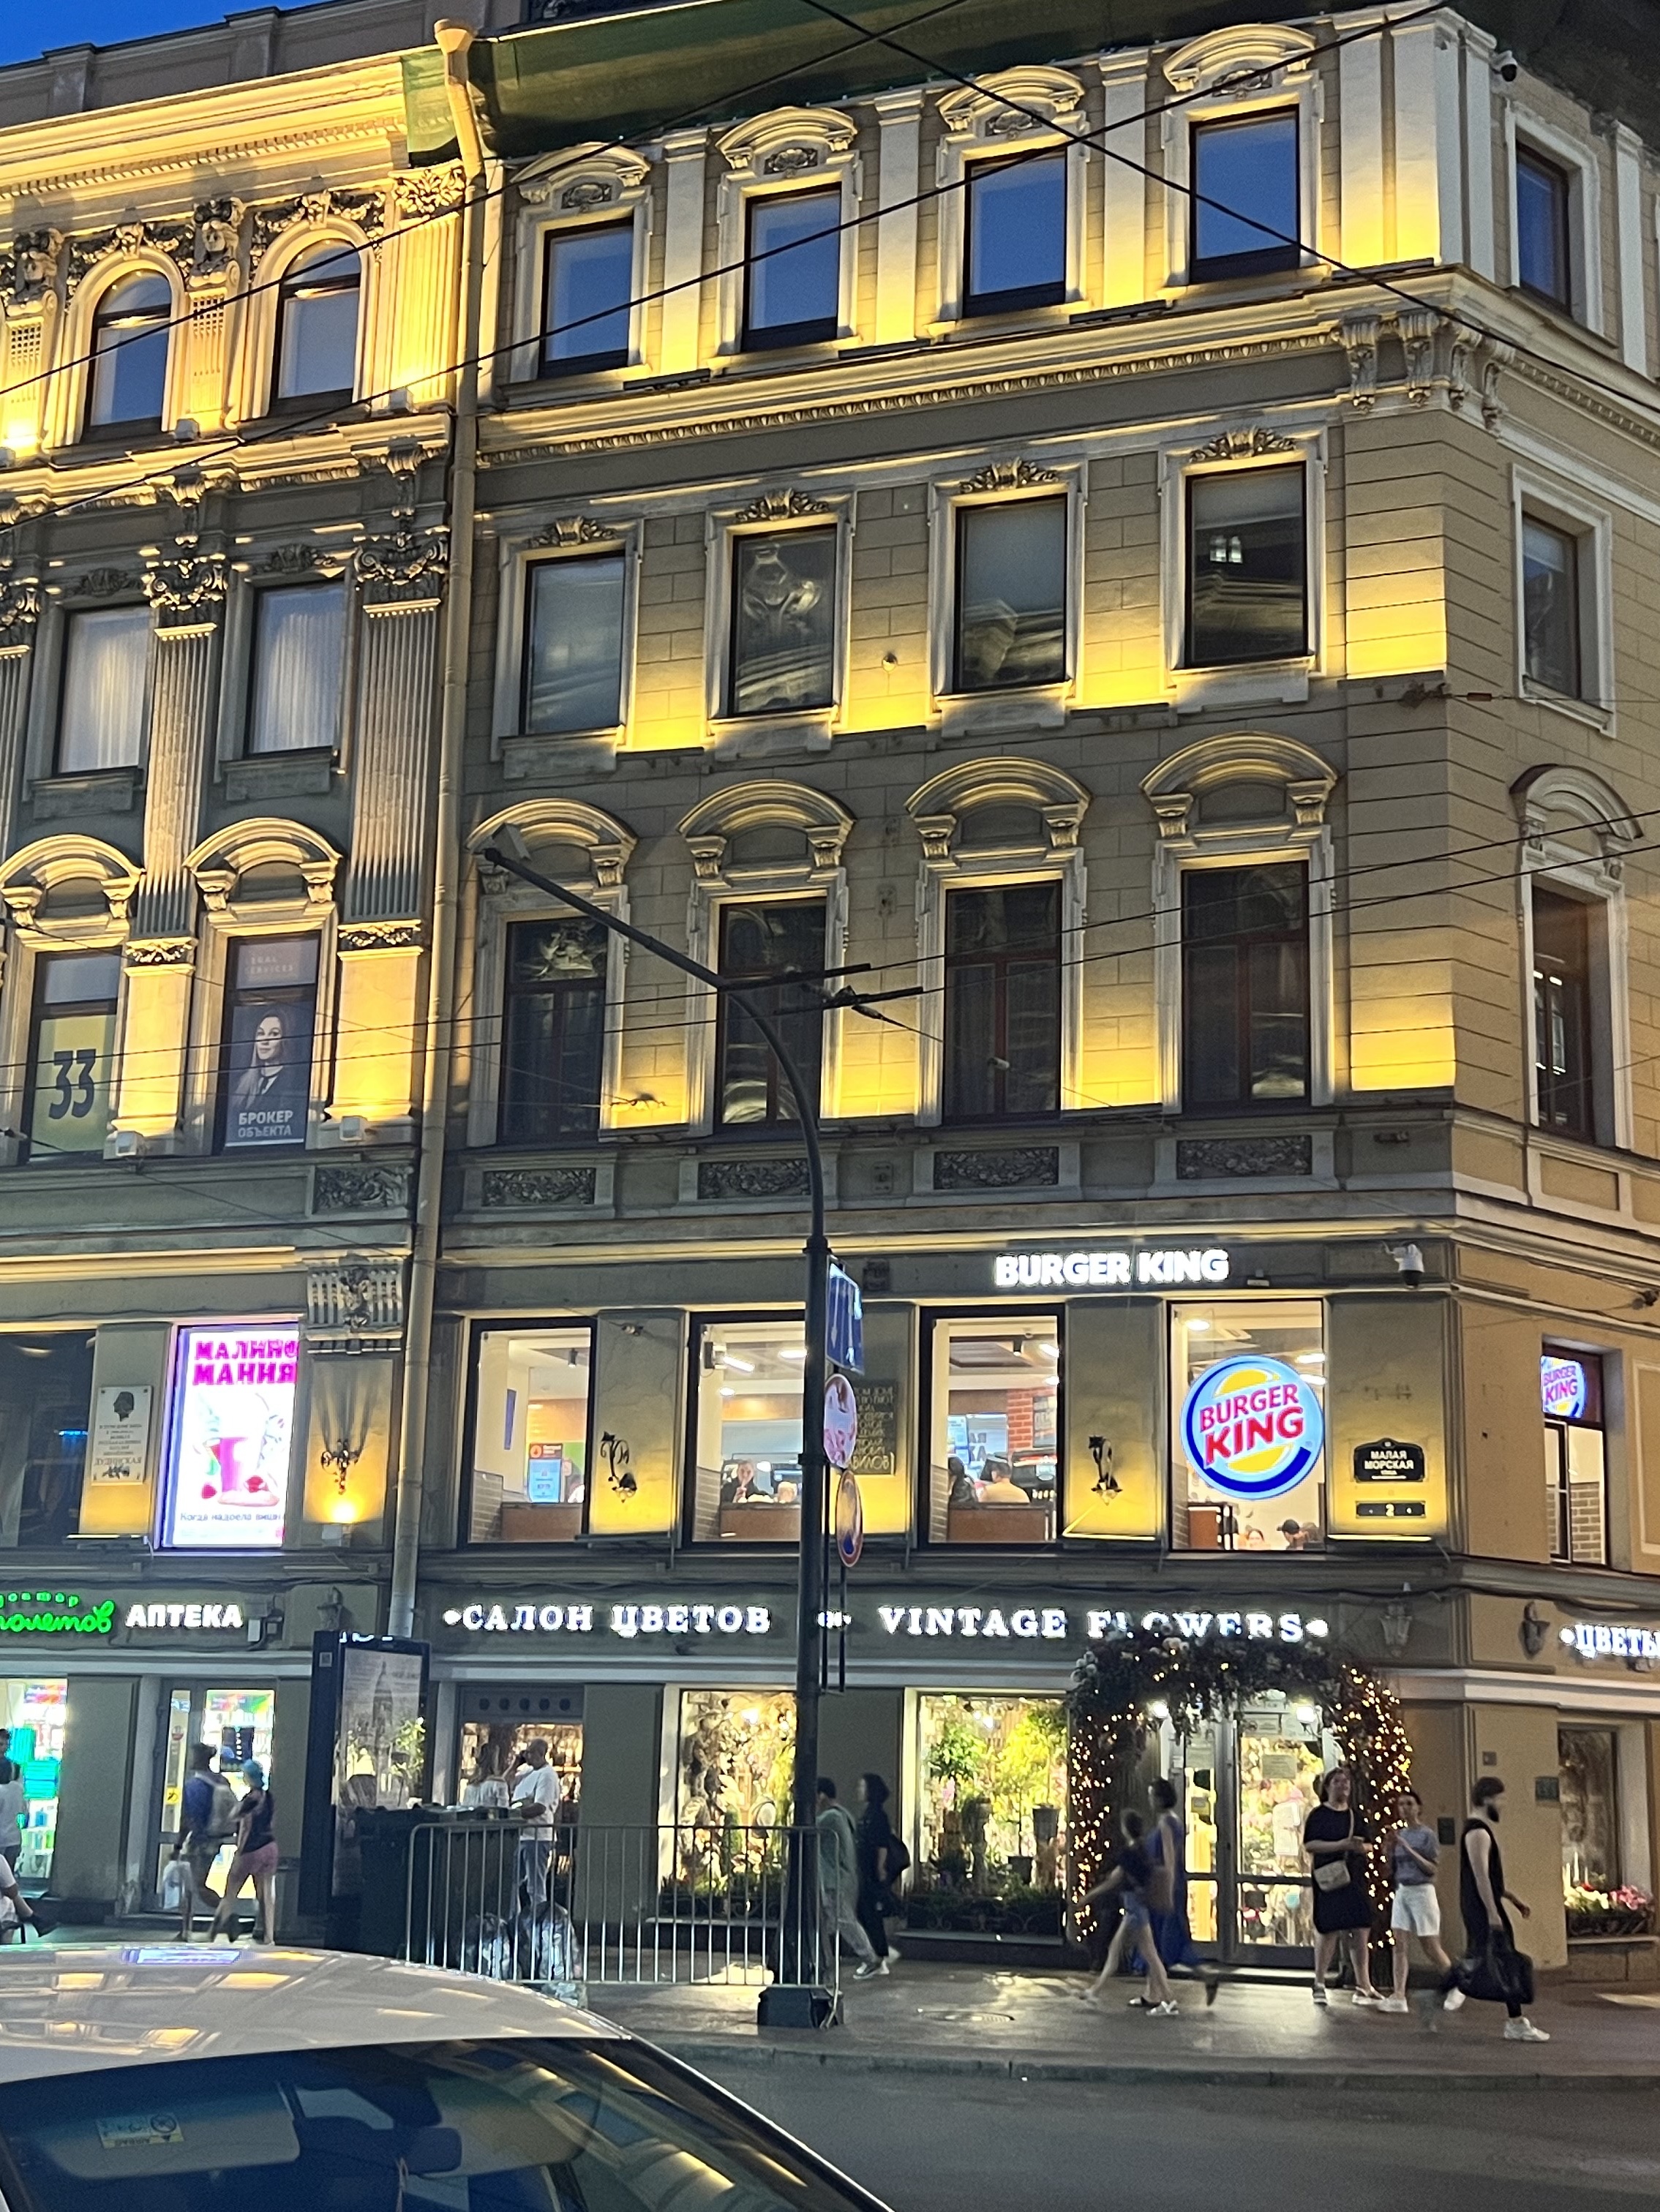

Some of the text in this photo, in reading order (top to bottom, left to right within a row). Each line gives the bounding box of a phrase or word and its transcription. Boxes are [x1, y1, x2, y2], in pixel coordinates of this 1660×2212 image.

[48, 1049, 97, 1119] 33
[239, 1110, 293, 1125] БРОКЕР
[237, 1125, 292, 1137] ОБЪЕКТА
[996, 1246, 1229, 1286] BURGER KING
[192, 1362, 297, 1385] МАНИЯ
[1545, 1379, 1578, 1405] KING
[1200, 1383, 1299, 1433] BURGER
[1206, 1406, 1304, 1467] KING
[1364, 1459, 1415, 1470] МОРСКАЯ
[1370, 1450, 1408, 1460] МАЛАЯ
[1385, 1503, 1394, 1517] 2
[125, 1603, 244, 1628] АПТЕКА
[462, 1603, 594, 1632] САЛОН
[610, 1604, 770, 1638] ЦВЕТОВ
[877, 1605, 1067, 1639] VINTAGE
